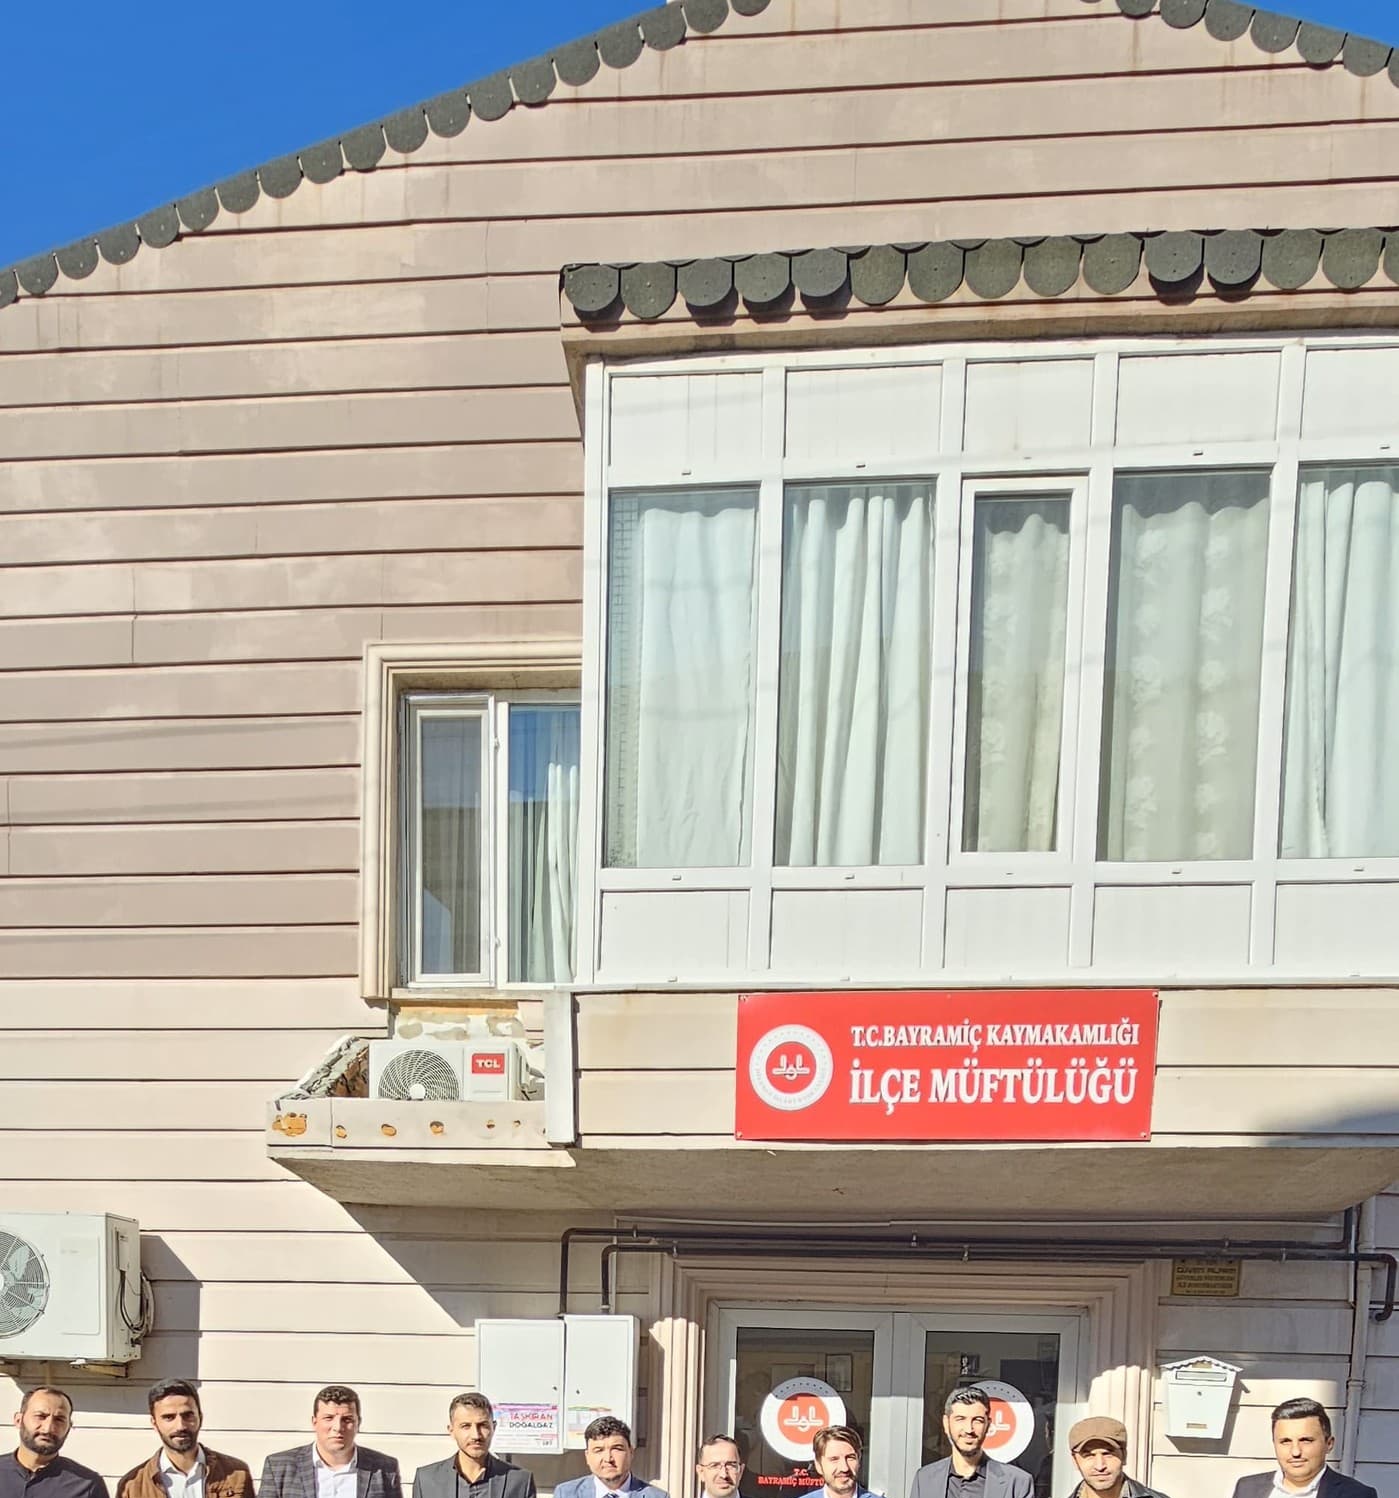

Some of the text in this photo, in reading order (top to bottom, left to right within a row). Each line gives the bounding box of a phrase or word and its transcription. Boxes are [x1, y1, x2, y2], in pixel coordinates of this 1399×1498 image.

[987, 1018, 1140, 1046] KAYMAKAMLIĞI
[475, 1059, 500, 1069] TCL
[850, 1058, 920, 1115] İLÇE
[928, 1057, 1138, 1104] MÜFTÜLÜĞÜ
[793, 1468, 809, 1476] T.C.
[799, 1477, 824, 1486] MÜFTÜ
